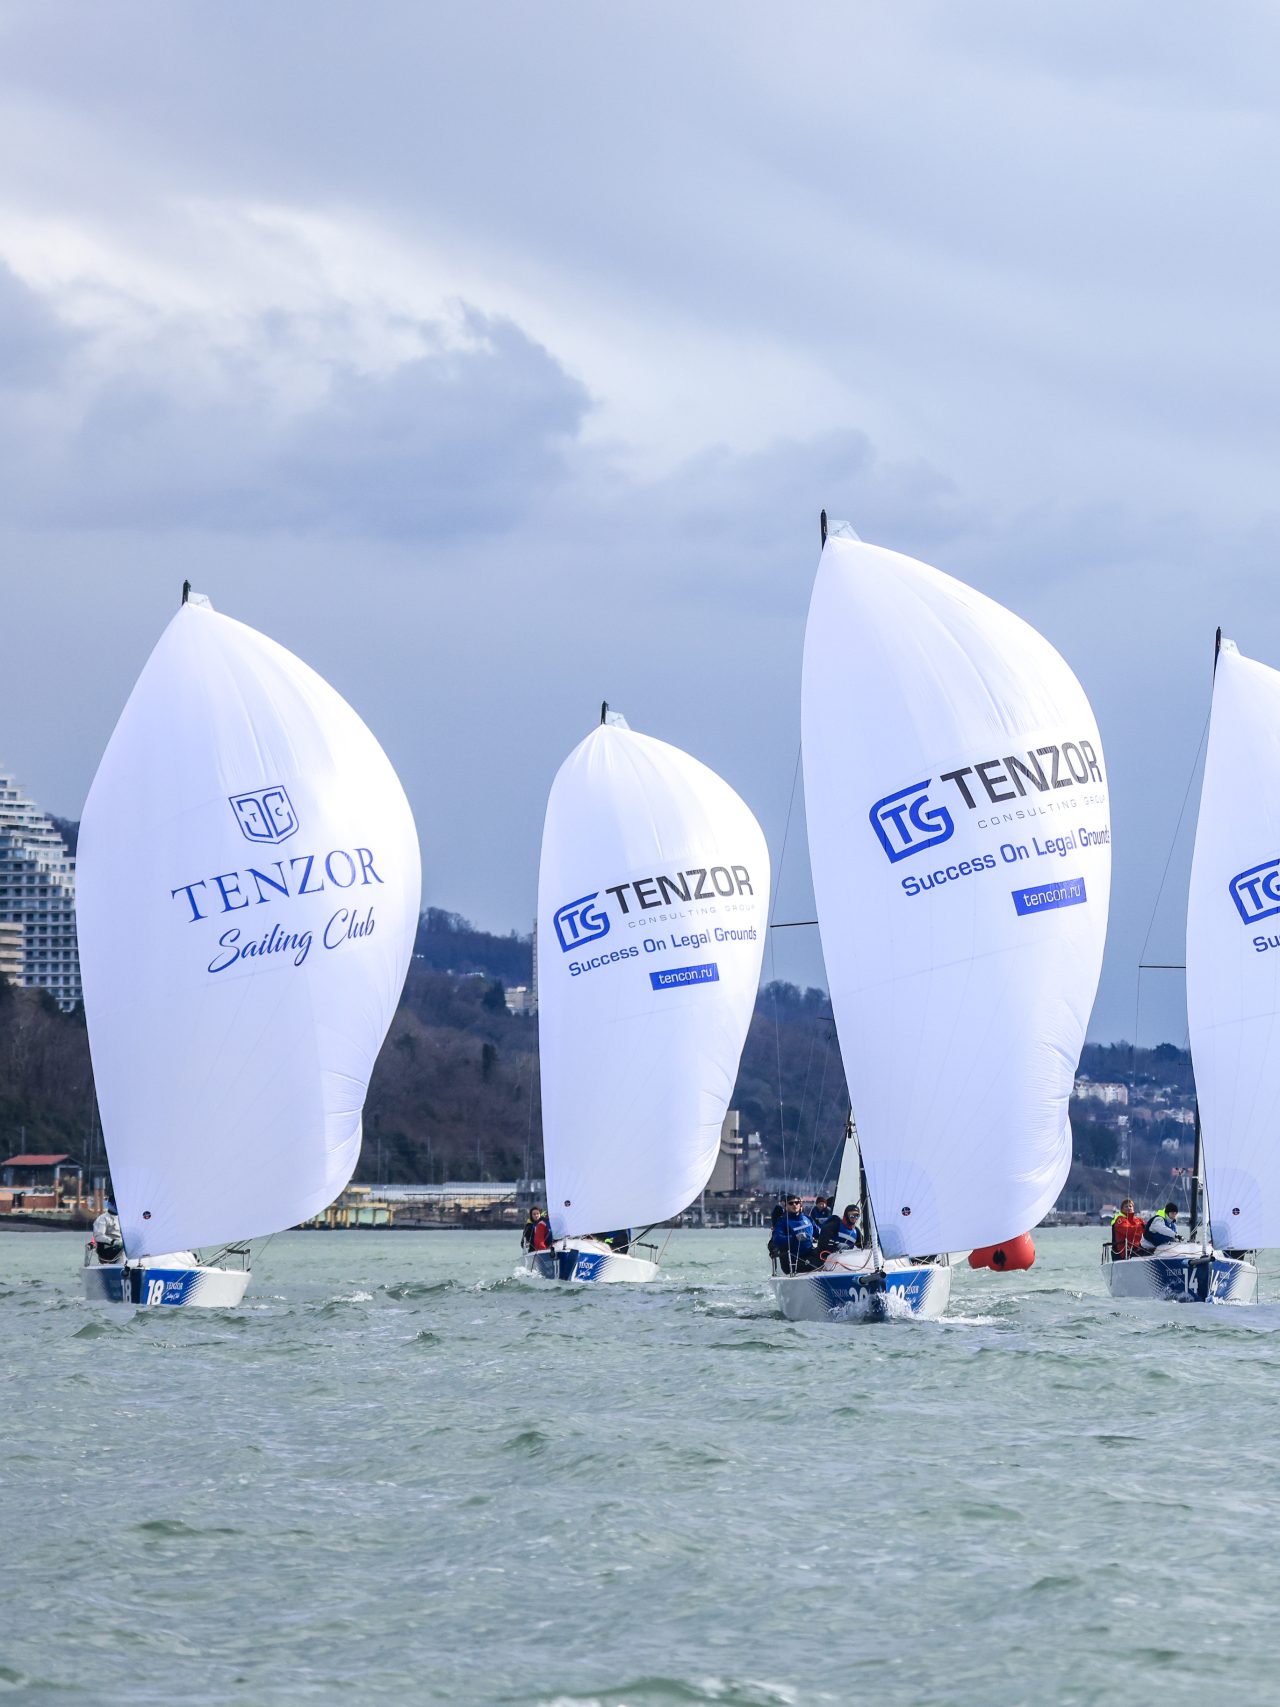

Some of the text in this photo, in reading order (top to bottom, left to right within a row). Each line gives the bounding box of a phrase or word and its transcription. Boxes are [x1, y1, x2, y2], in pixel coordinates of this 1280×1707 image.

[940, 740, 1103, 810] TENZOR
[977, 799, 1077, 829] CONSULTING
[901, 853, 996, 897] Success
[1000, 843, 1030, 863] On
[1032, 830, 1077, 857] Legal
[171, 848, 384, 923] TENZOR
[605, 865, 754, 914] TENZOR
[1023, 884, 1081, 907] tencon.ru
[628, 906, 717, 928] CONSULTING
[208, 906, 375, 973] Sailing Club
[568, 926, 757, 977] Success On Legal Grounds
[658, 966, 713, 985] tencon.ru
[121, 1280, 132, 1303] 18
[147, 1280, 164, 1305] 18
[1183, 1267, 1198, 1294] 14
